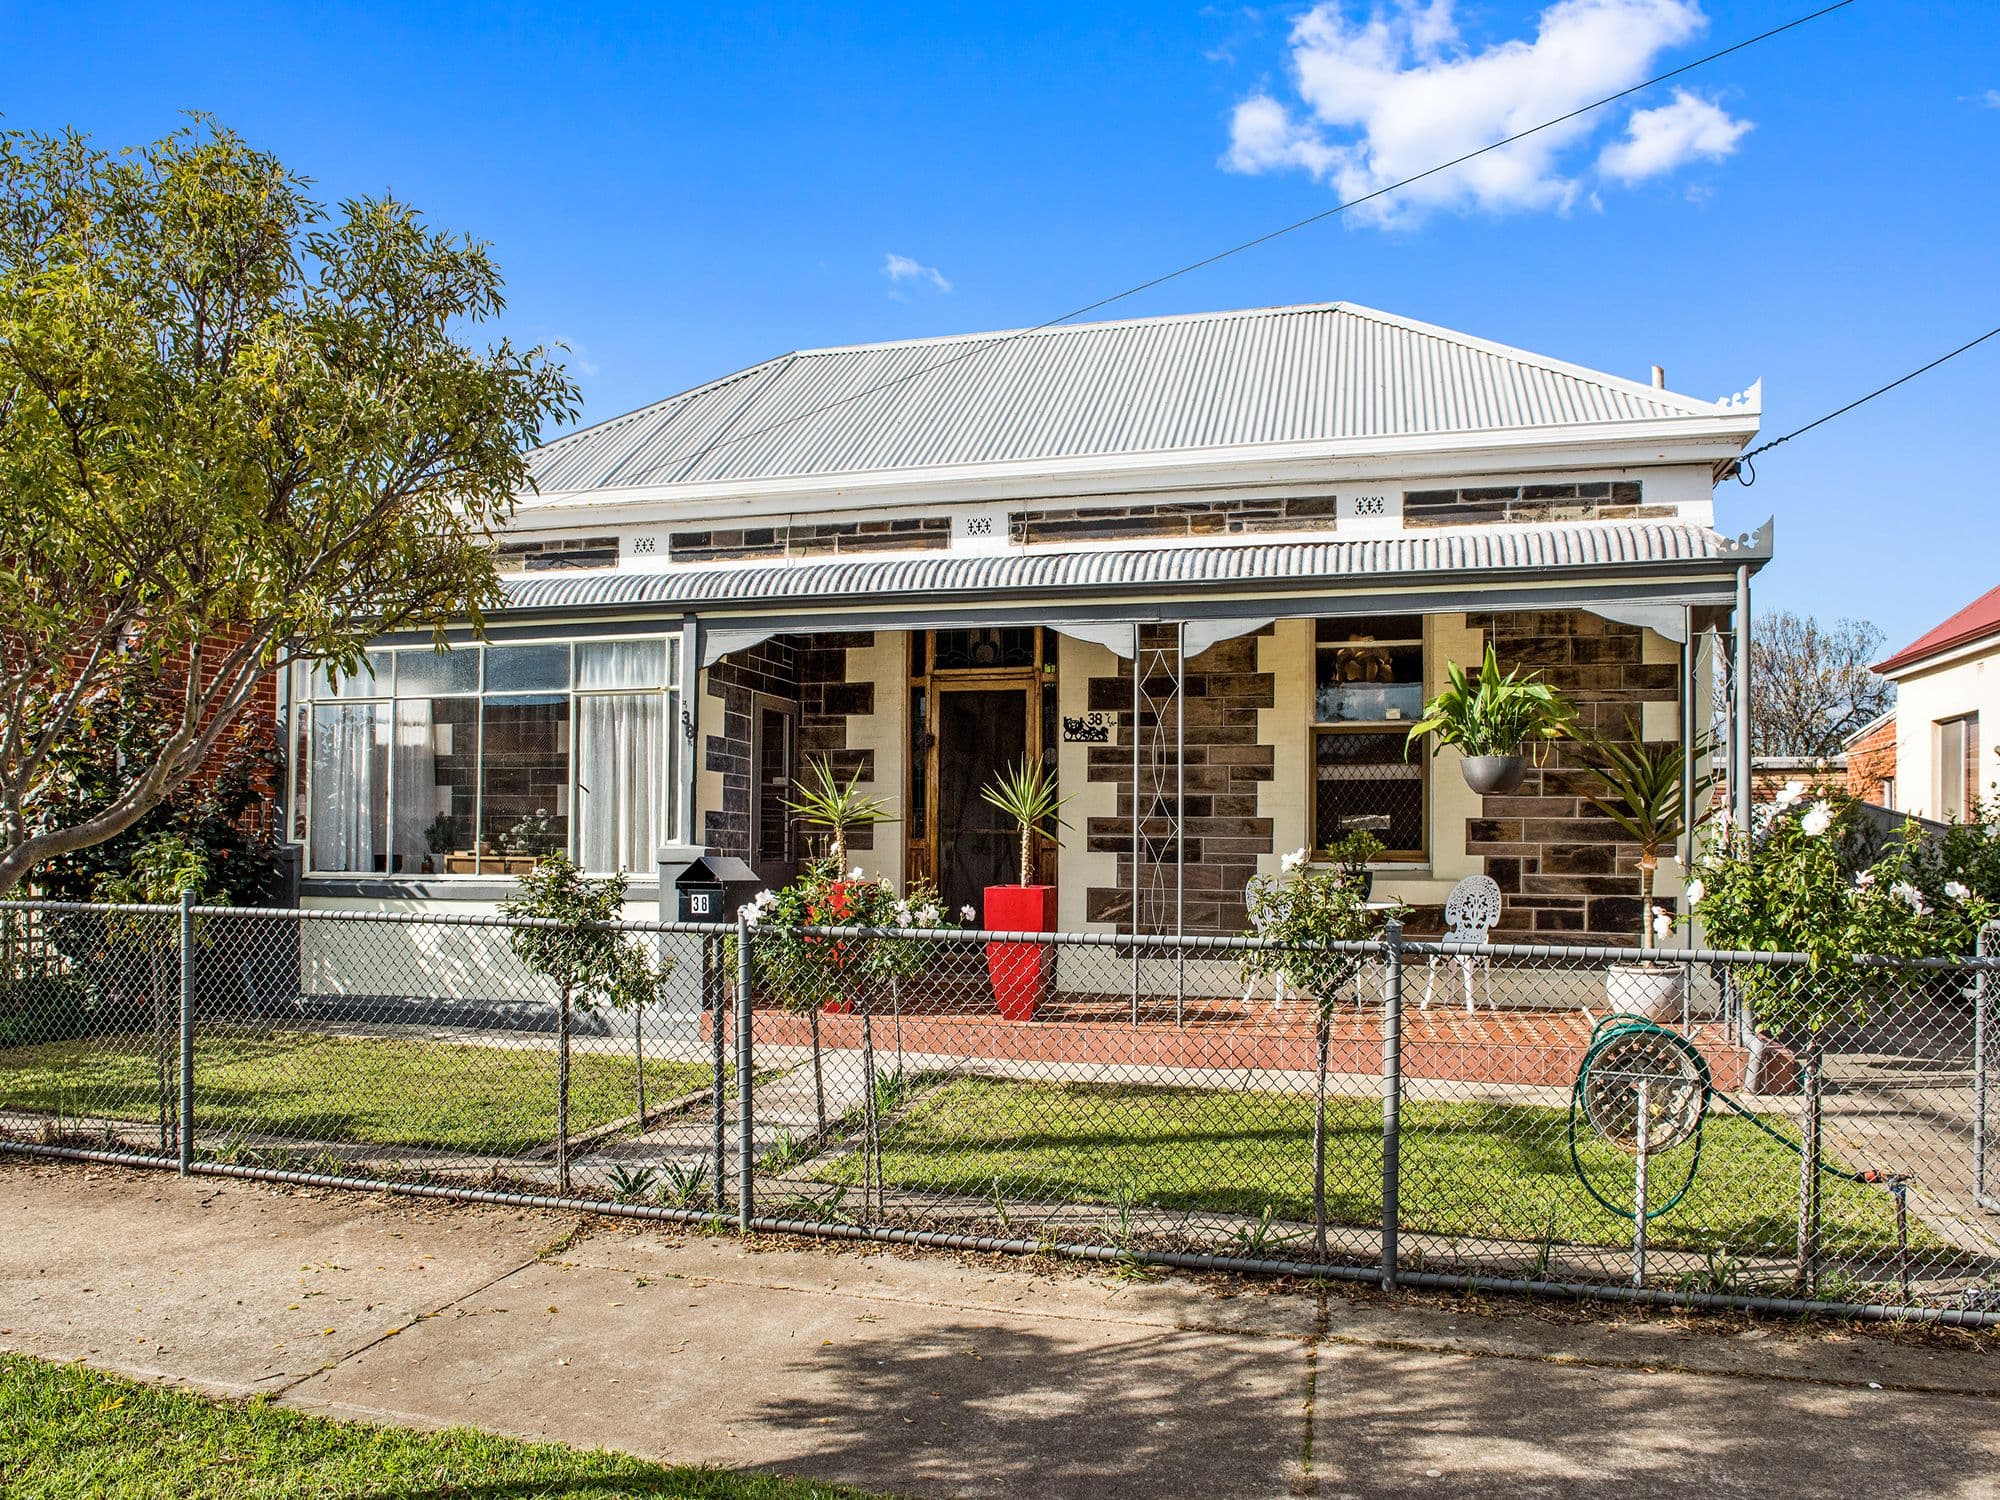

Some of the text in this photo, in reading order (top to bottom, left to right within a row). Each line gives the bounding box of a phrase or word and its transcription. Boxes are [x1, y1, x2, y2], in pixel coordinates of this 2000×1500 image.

[681, 710, 694, 739] 38
[1087, 712, 1103, 726] 38
[693, 896, 708, 912] 38
